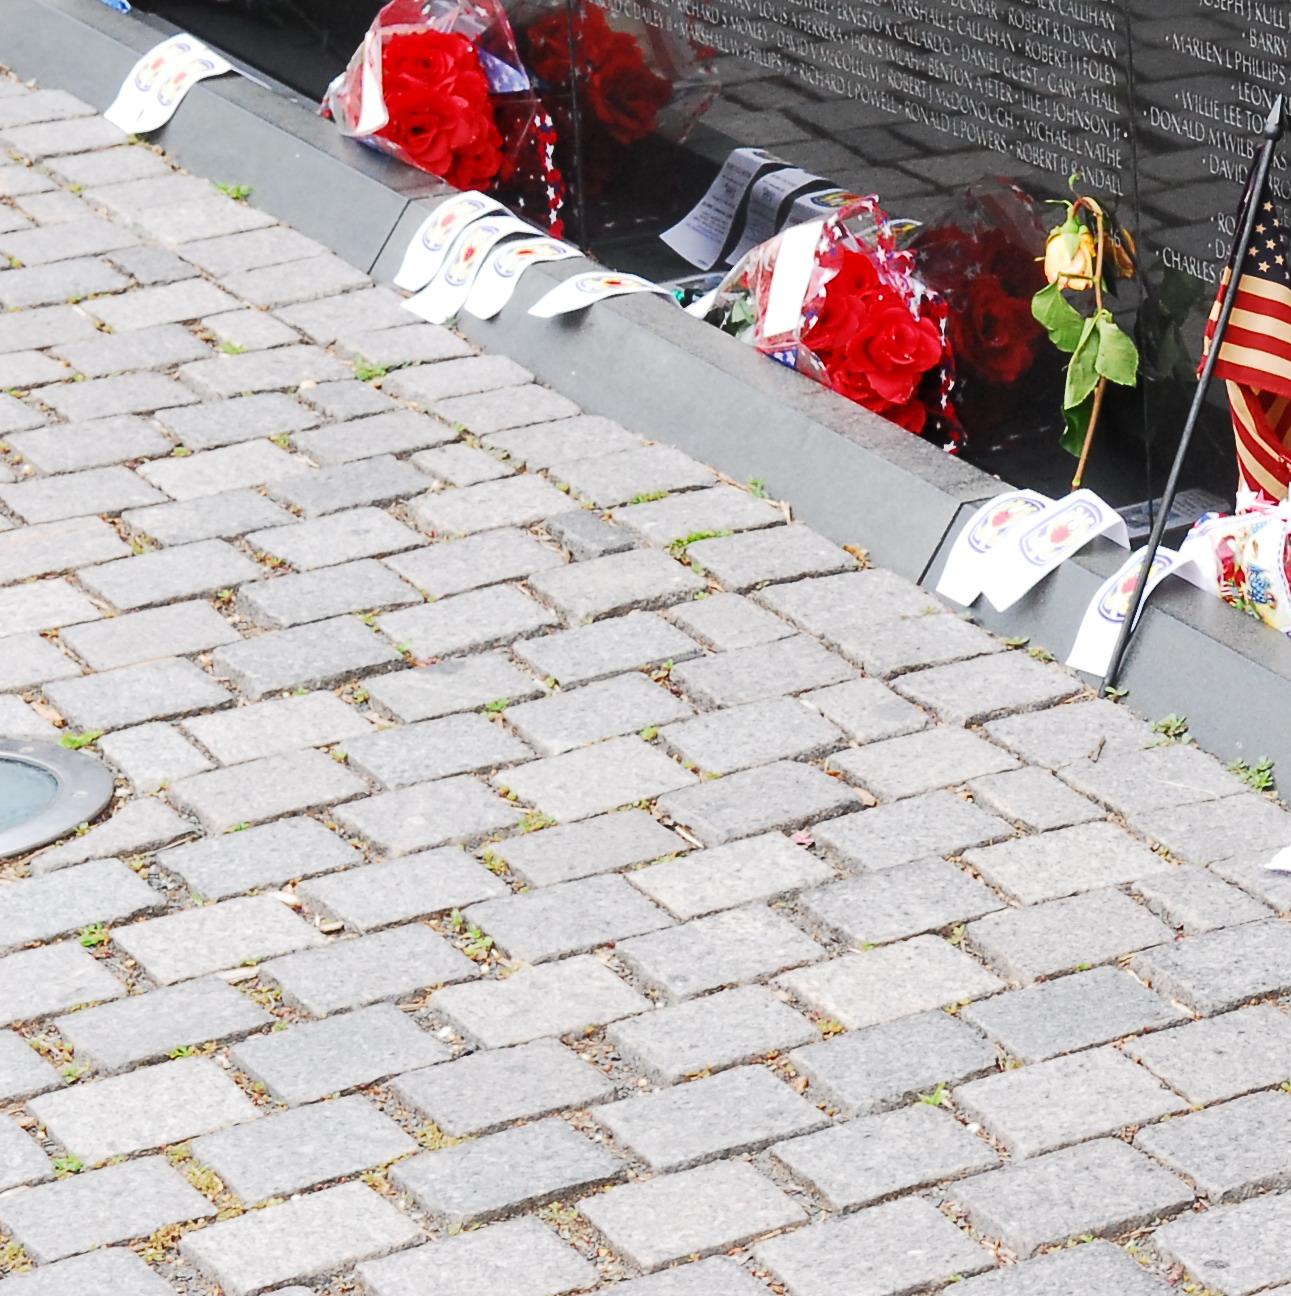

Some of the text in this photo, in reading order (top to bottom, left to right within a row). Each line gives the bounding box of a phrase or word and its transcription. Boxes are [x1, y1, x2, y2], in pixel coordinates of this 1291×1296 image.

[1024, 120, 1122, 168] MICHAEL L NATHE
